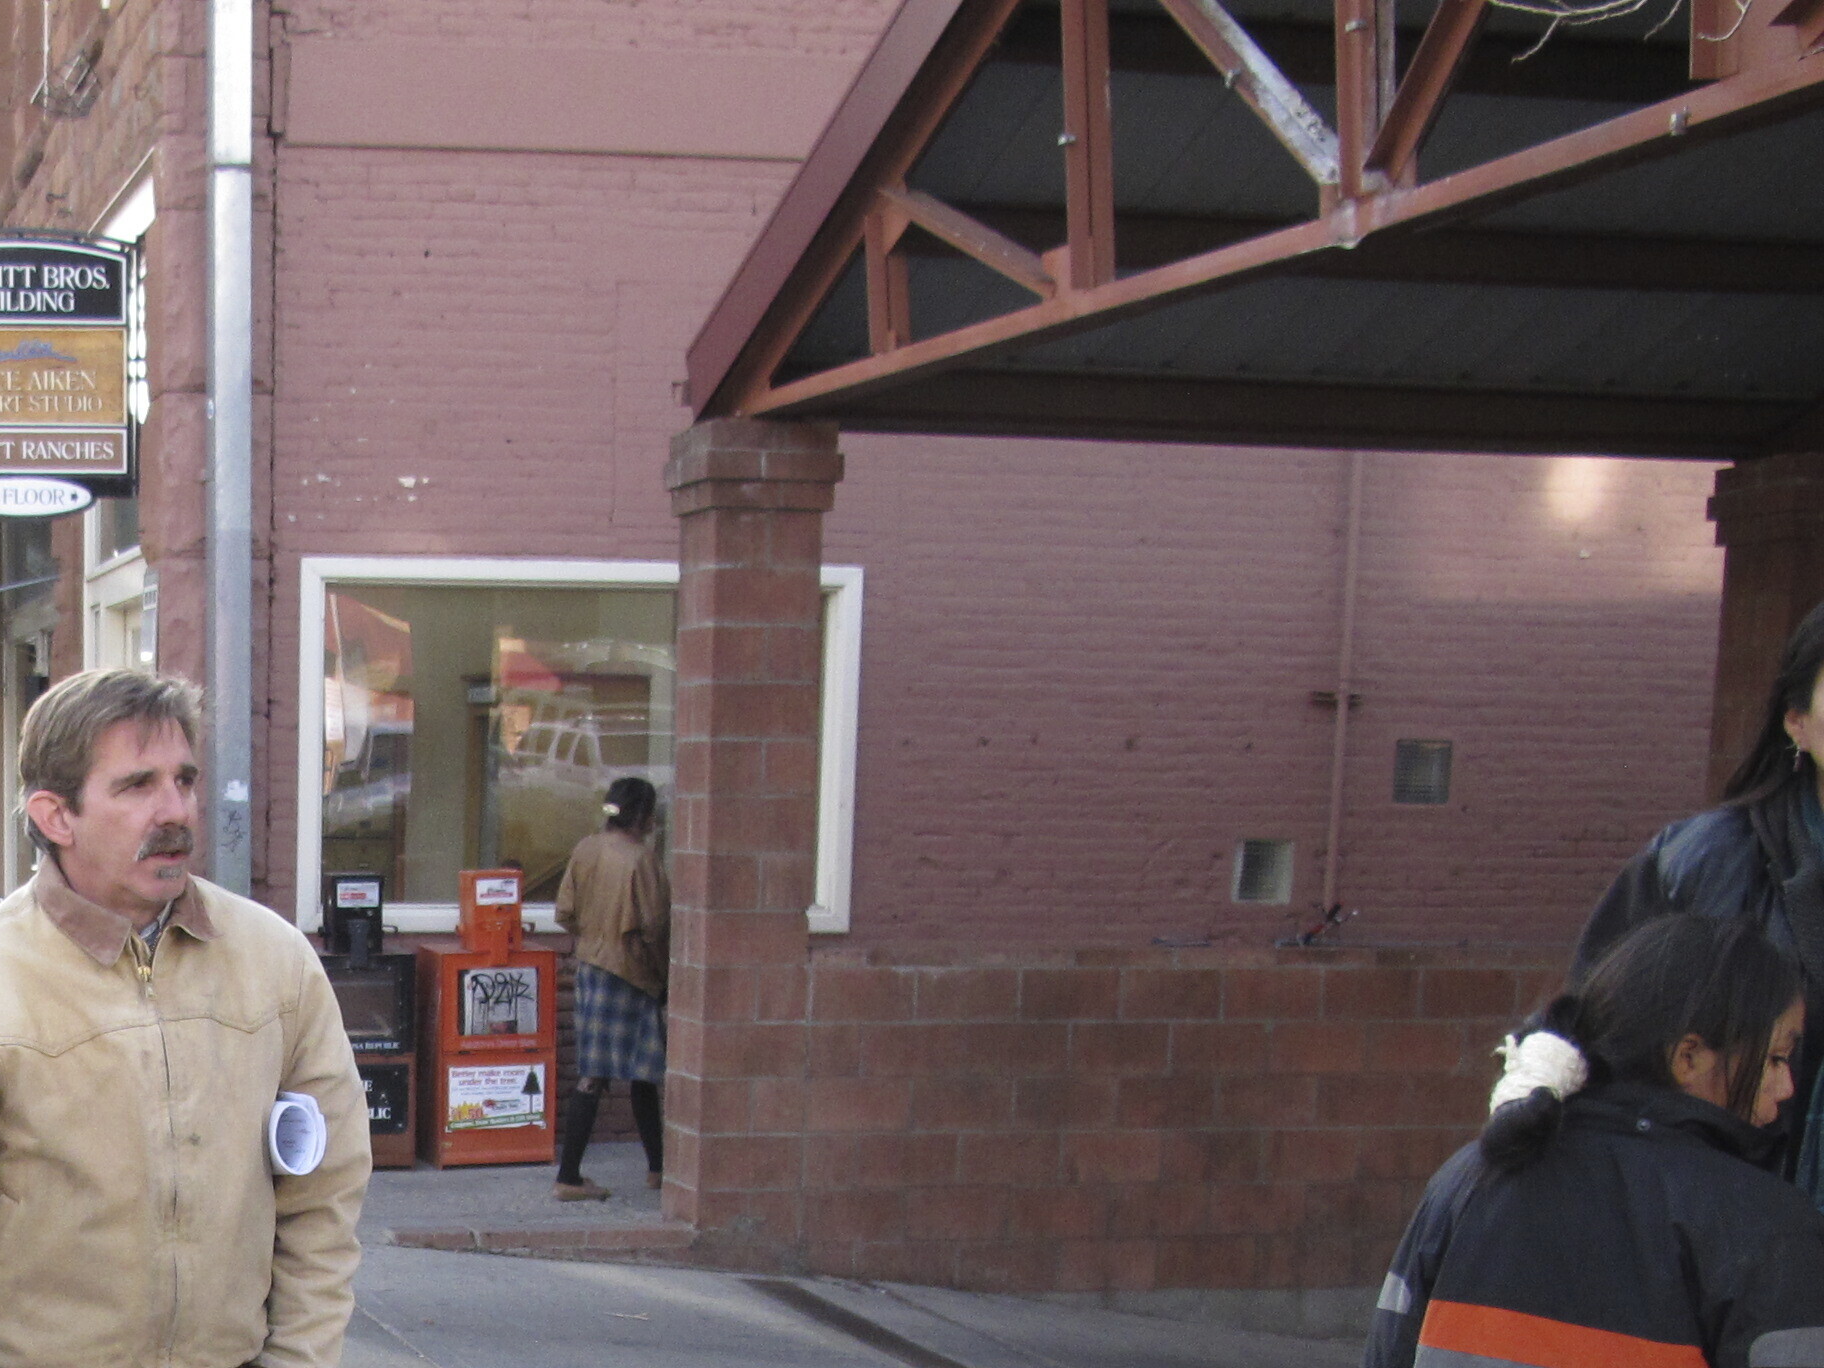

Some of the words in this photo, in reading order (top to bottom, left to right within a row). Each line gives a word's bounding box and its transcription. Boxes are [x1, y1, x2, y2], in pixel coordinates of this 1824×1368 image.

[43, 265, 111, 290] BROS.
[28, 370, 97, 392] AIKEN
[28, 395, 103, 413] STUDIO
[21, 441, 115, 460] RANCHES
[3, 489, 65, 505] FLOOR
